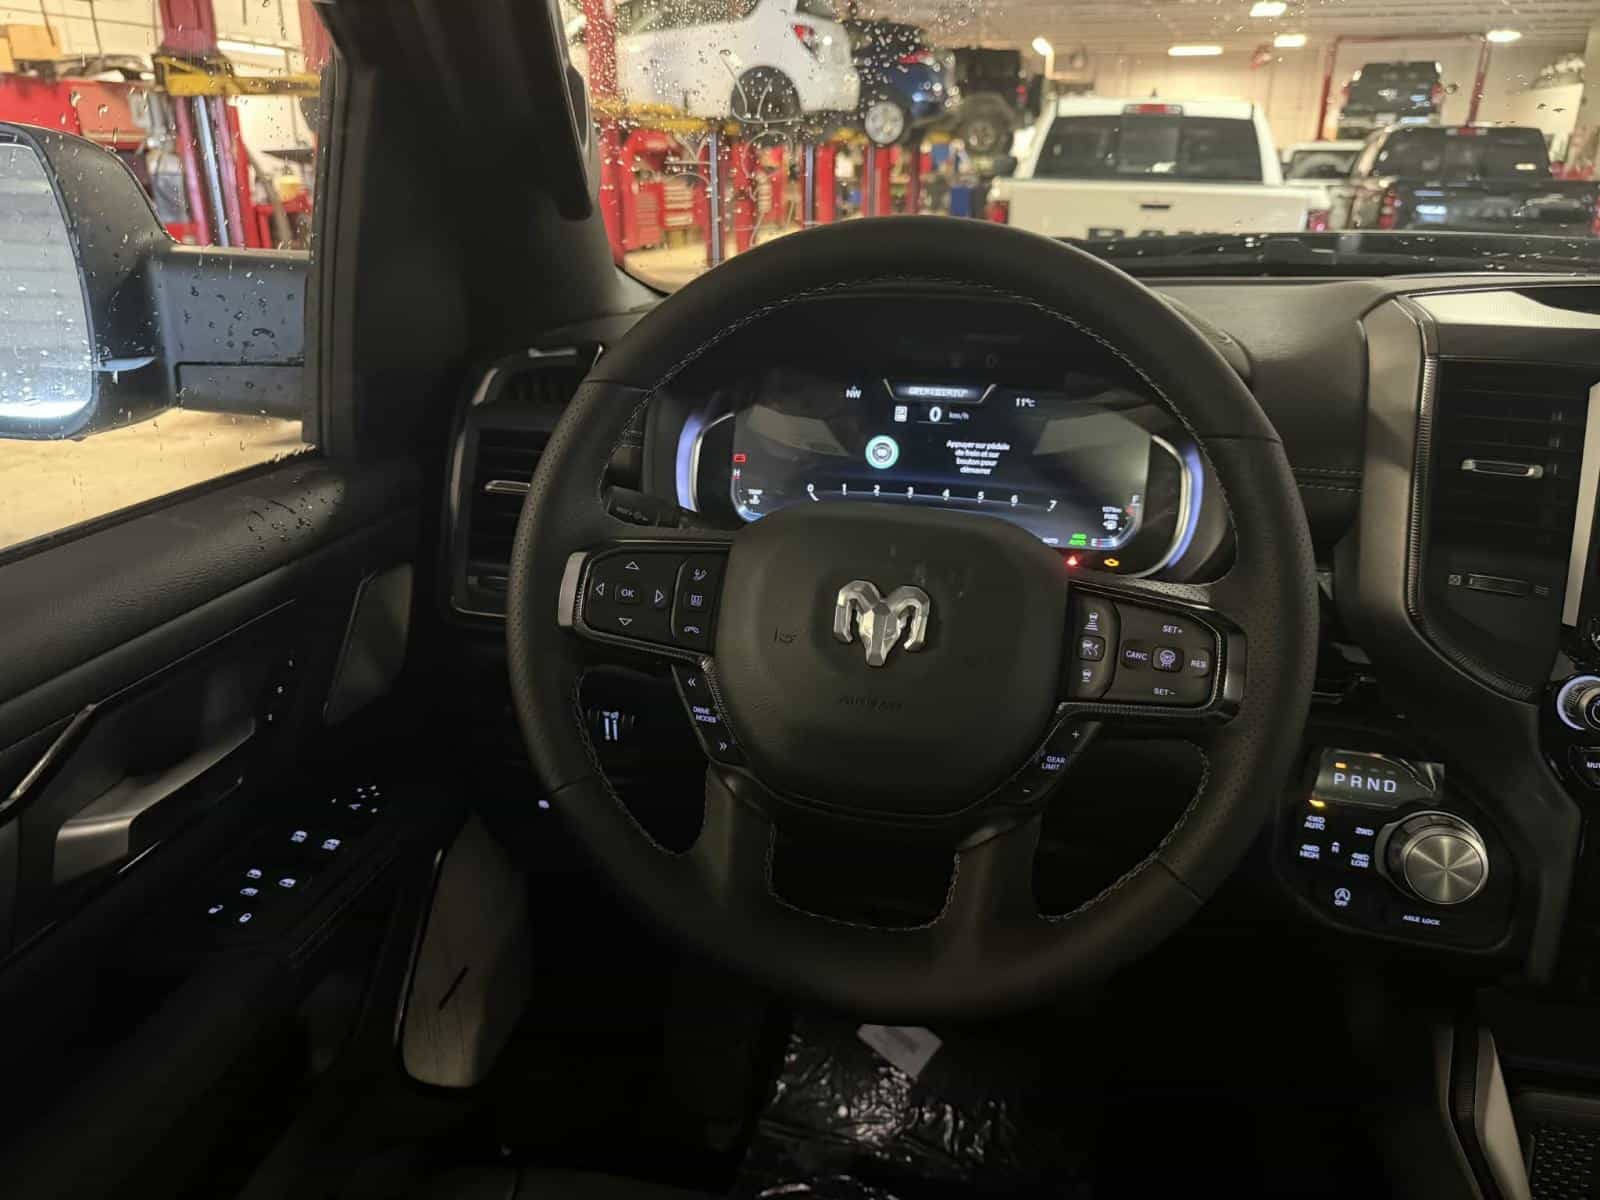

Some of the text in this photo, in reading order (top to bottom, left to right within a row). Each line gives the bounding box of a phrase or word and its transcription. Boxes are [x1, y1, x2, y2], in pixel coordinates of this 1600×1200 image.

[846, 389, 862, 399] NW
[929, 406, 942, 422] 0
[1047, 500, 1058, 512] 7
[621, 588, 635, 598] OK
[1126, 650, 1148, 661] CANC
